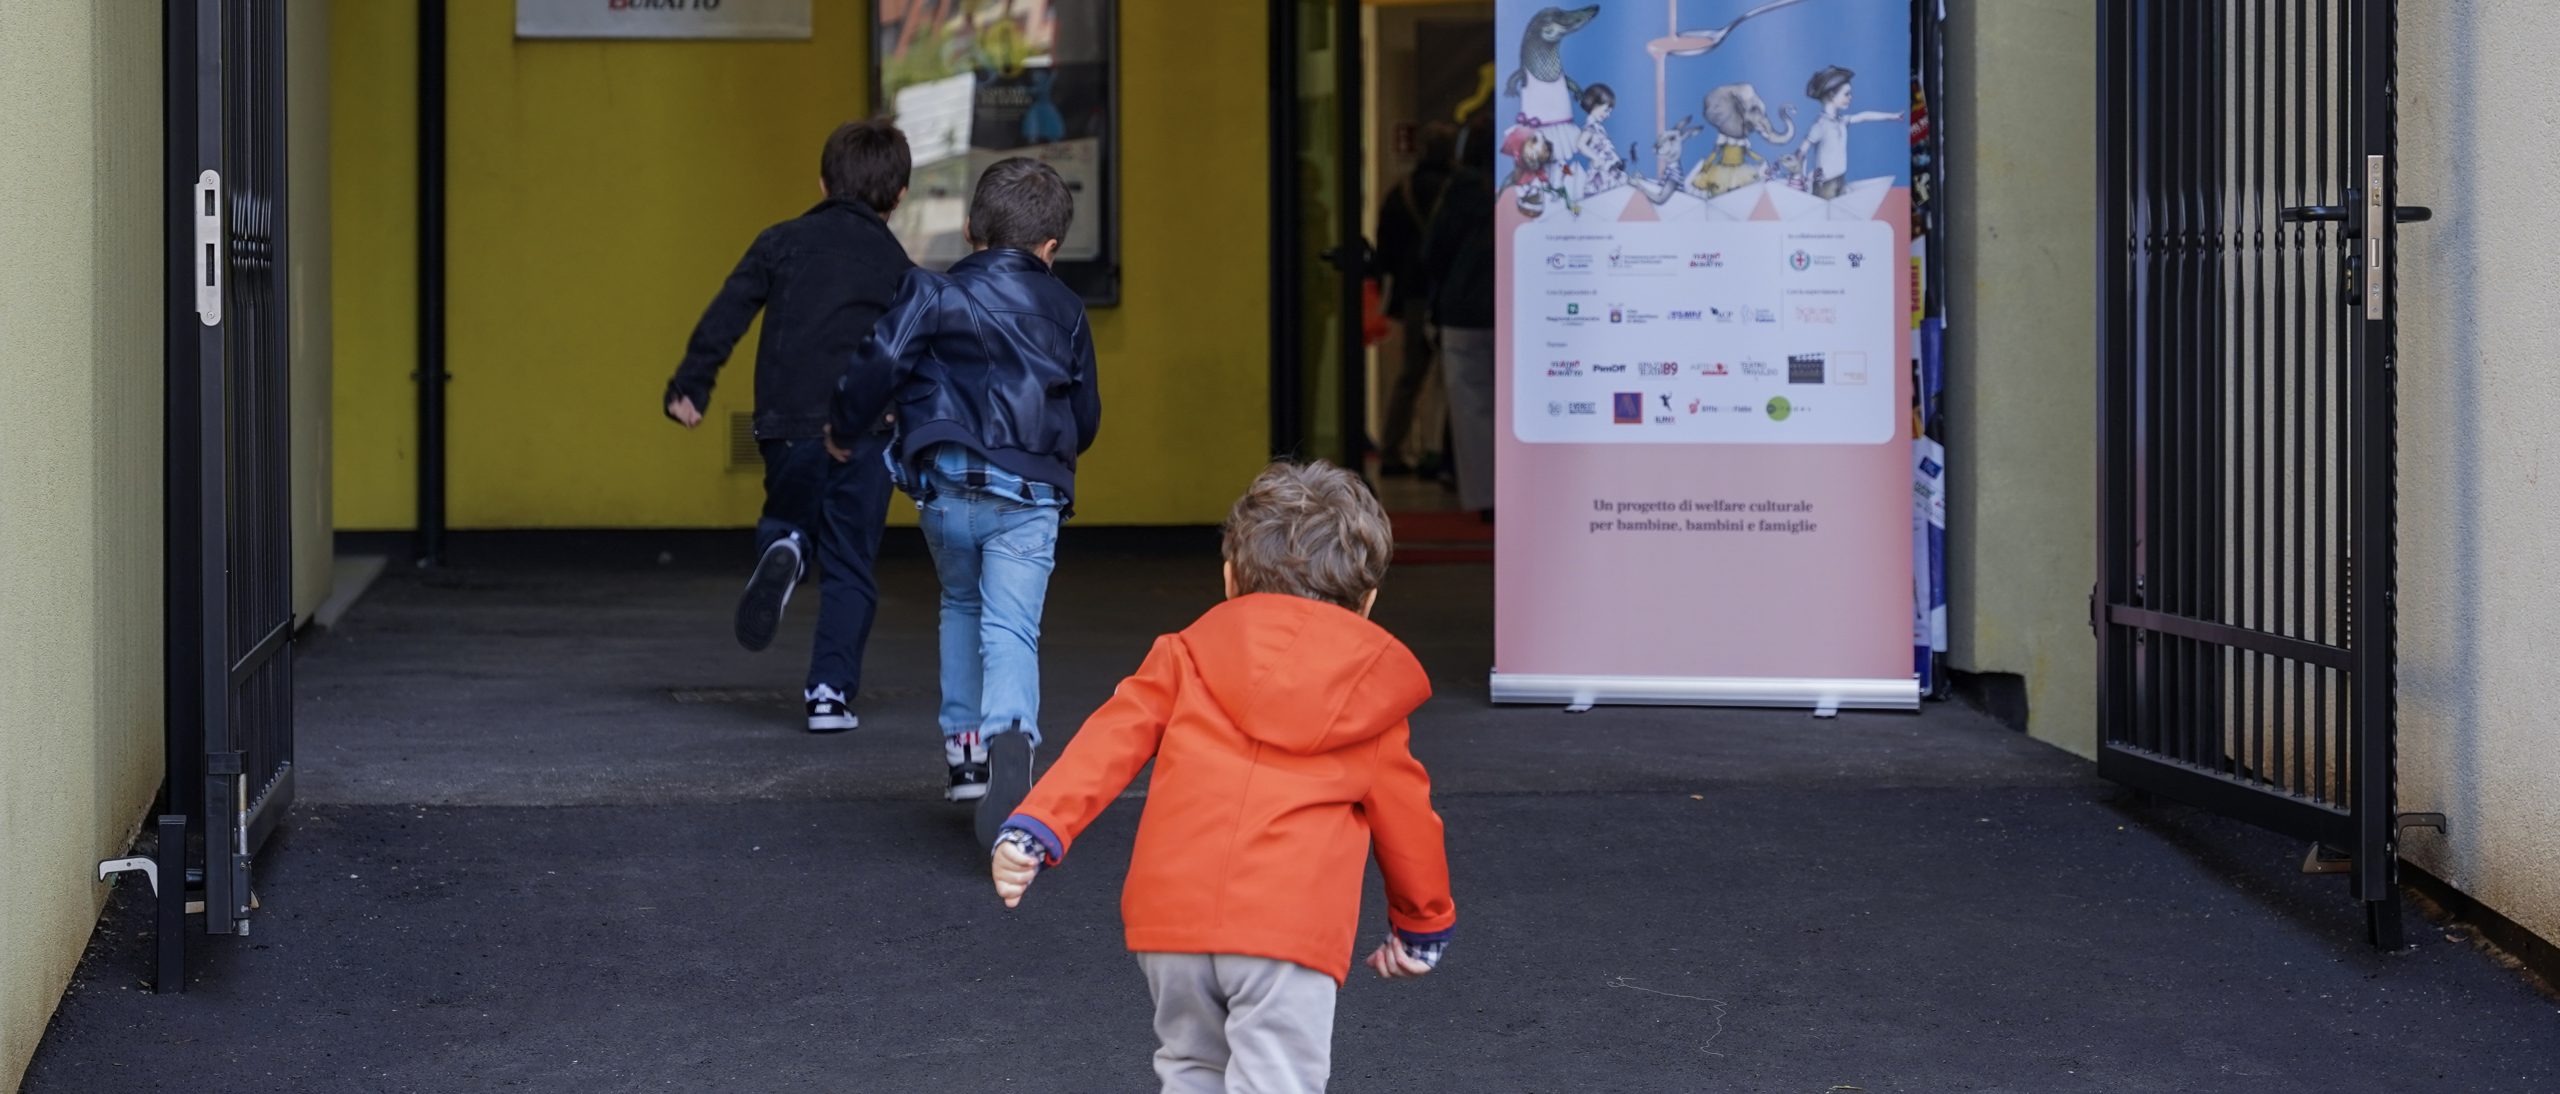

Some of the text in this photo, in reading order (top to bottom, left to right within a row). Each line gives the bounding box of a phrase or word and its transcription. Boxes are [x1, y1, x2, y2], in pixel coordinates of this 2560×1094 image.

[1593, 499, 1814, 515] Un progetto di welfare culturale
[1589, 519, 1818, 535] per bambine, bambini e famiglie
